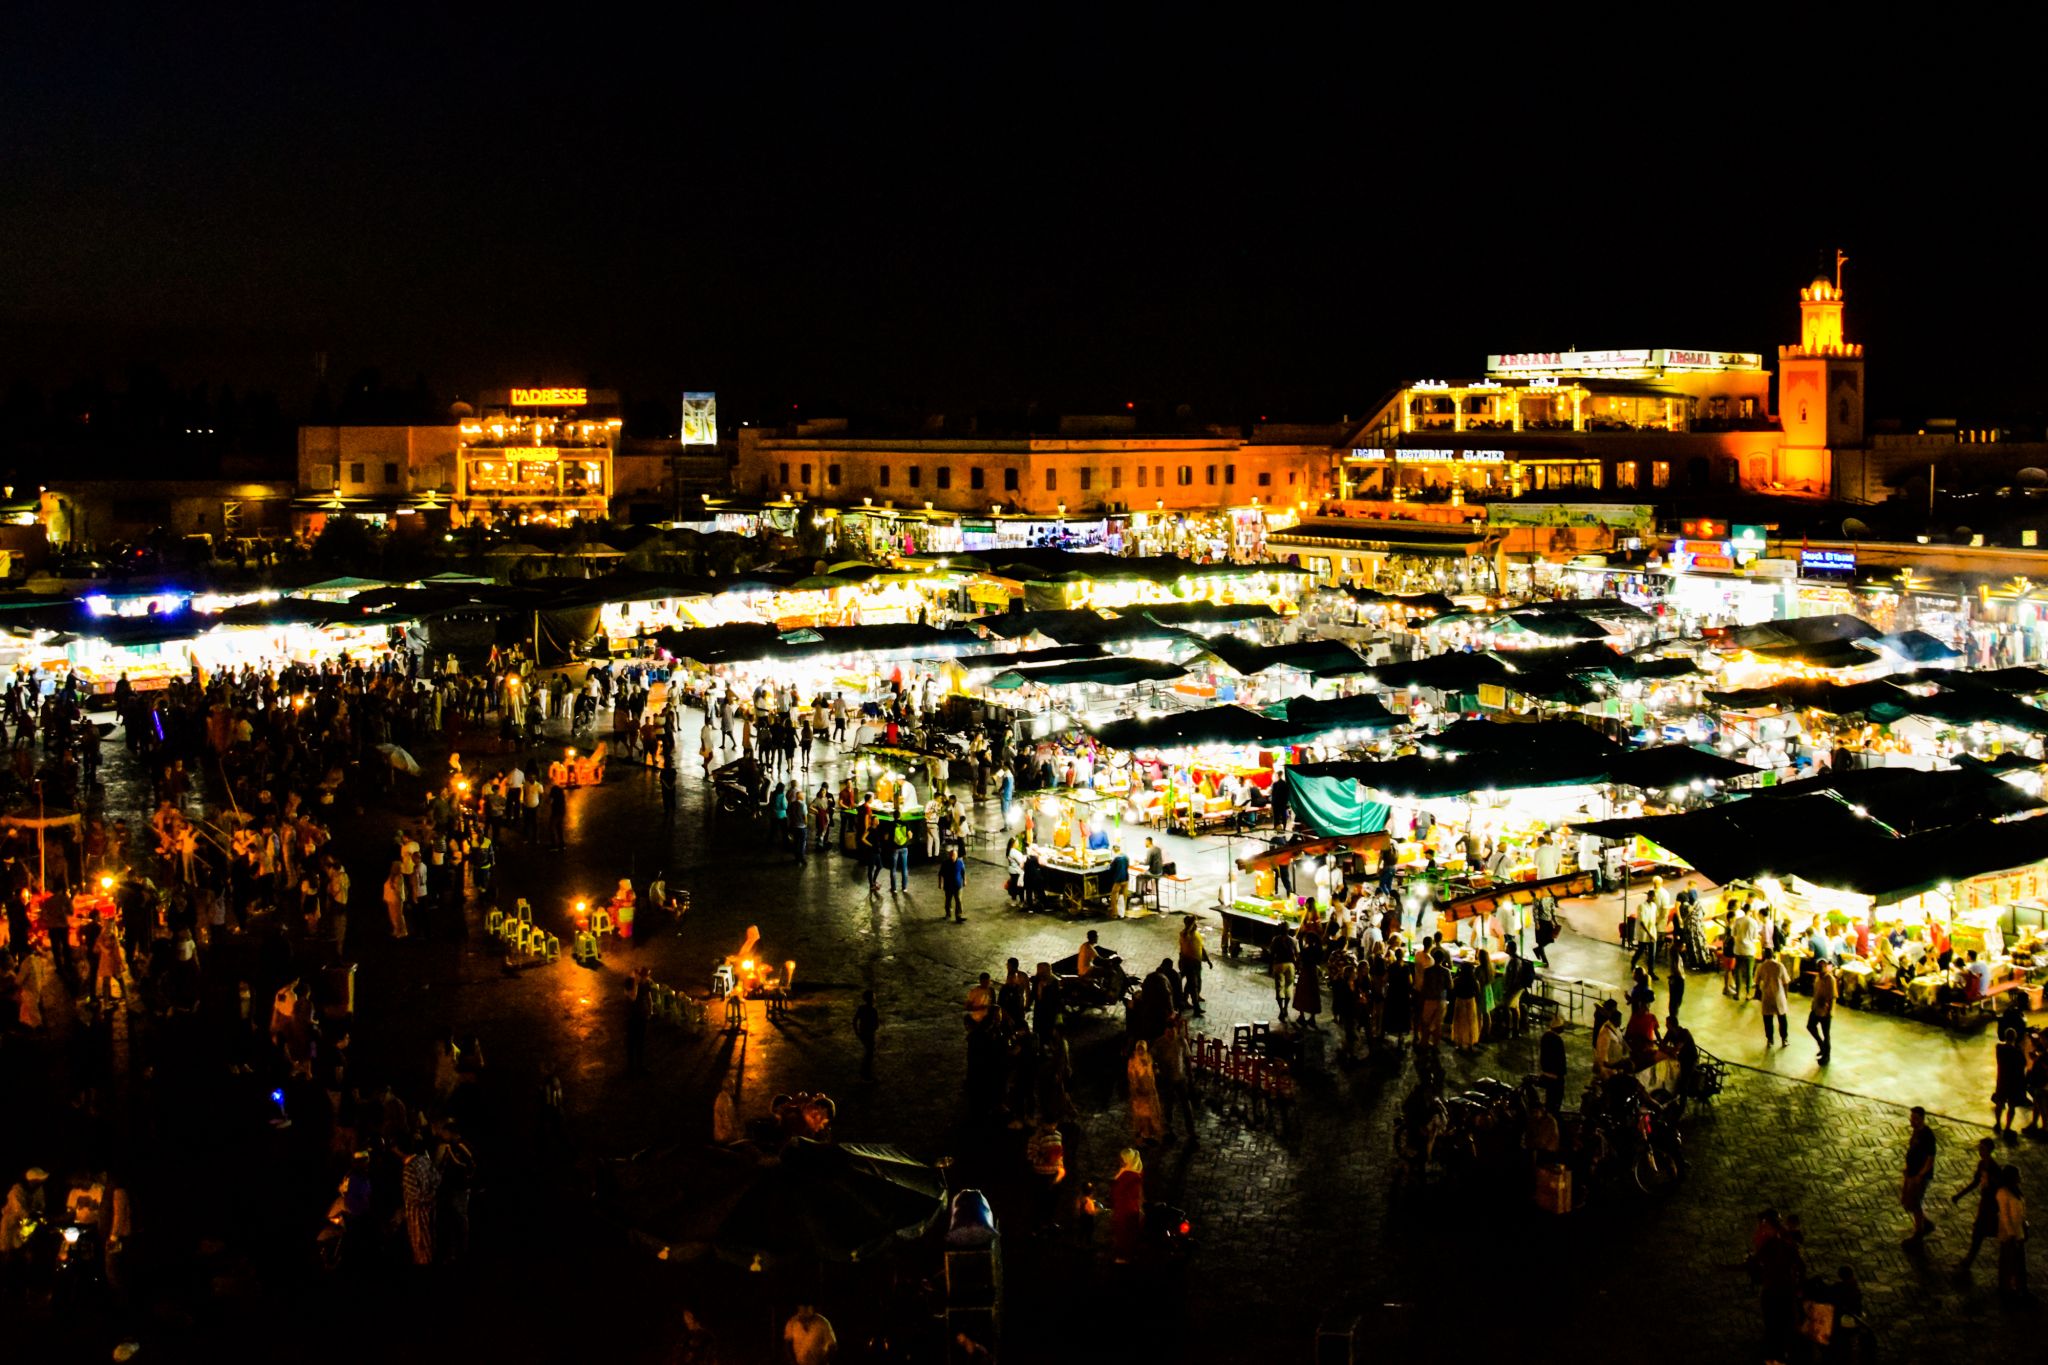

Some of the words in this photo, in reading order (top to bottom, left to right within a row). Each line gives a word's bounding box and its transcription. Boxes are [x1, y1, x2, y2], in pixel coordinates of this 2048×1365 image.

[1499, 353, 1562, 366] ARGANA
[1668, 351, 1711, 364] ARGANA
[511, 388, 588, 405] L'ADRESSE
[1352, 448, 1386, 459] ARGANA
[1395, 449, 1455, 460] RESTAURANT
[1462, 450, 1505, 460] GLACIER
